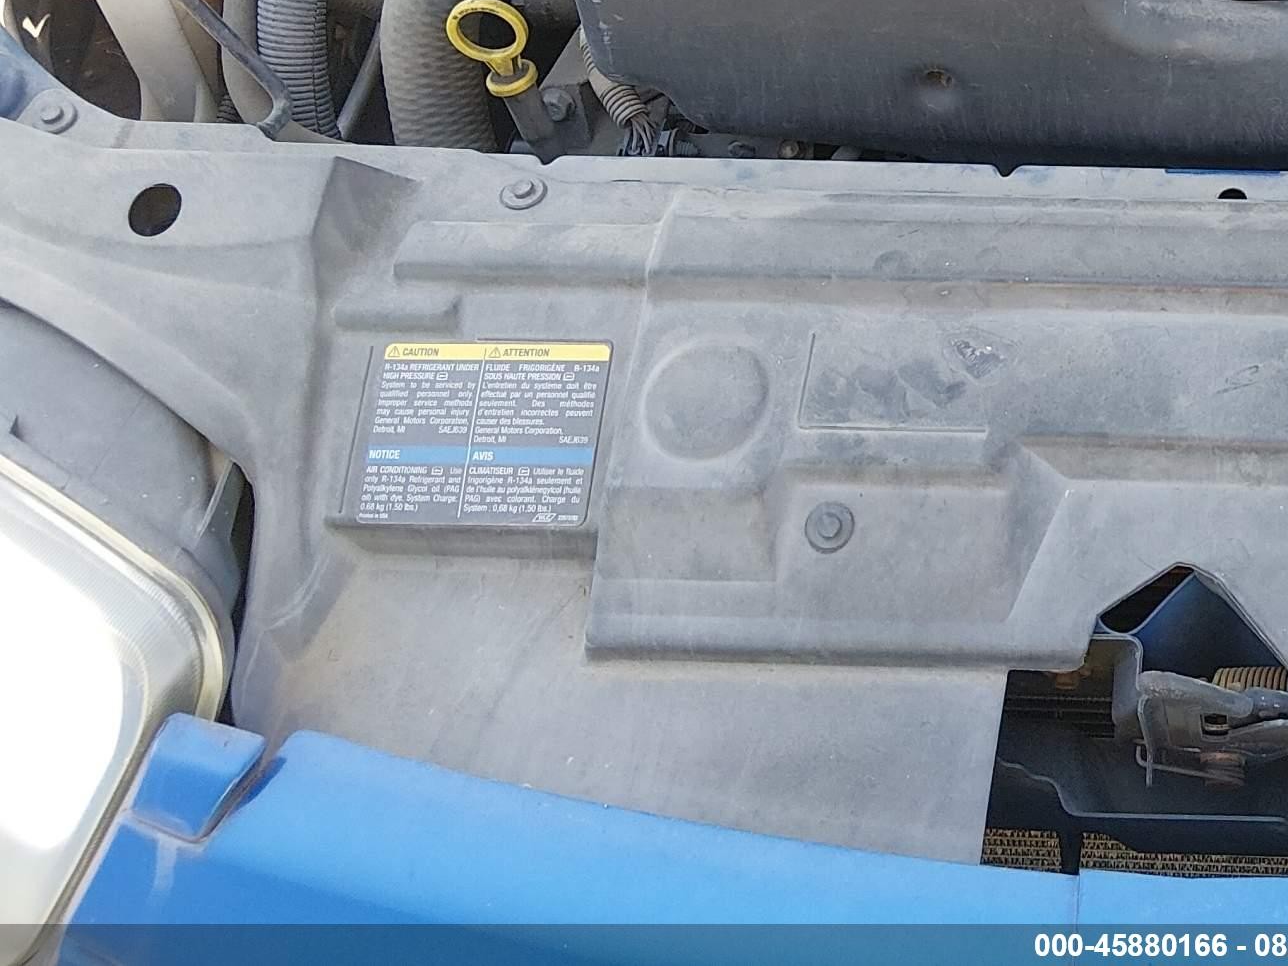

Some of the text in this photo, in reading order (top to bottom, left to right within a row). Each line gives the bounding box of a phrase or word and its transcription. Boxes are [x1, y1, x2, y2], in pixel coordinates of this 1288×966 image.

[403, 348, 439, 356] CAUTION
[369, 450, 400, 459] NOTICE
[473, 451, 493, 461] AVIS
[380, 466, 427, 474] CONDITIONING
[469, 467, 513, 475] CLIMATISEUR
[409, 476, 445, 484] Refrigerant
[408, 485, 427, 493] Glycol
[542, 496, 566, 504] Charge
[509, 505, 517, 513] kg
